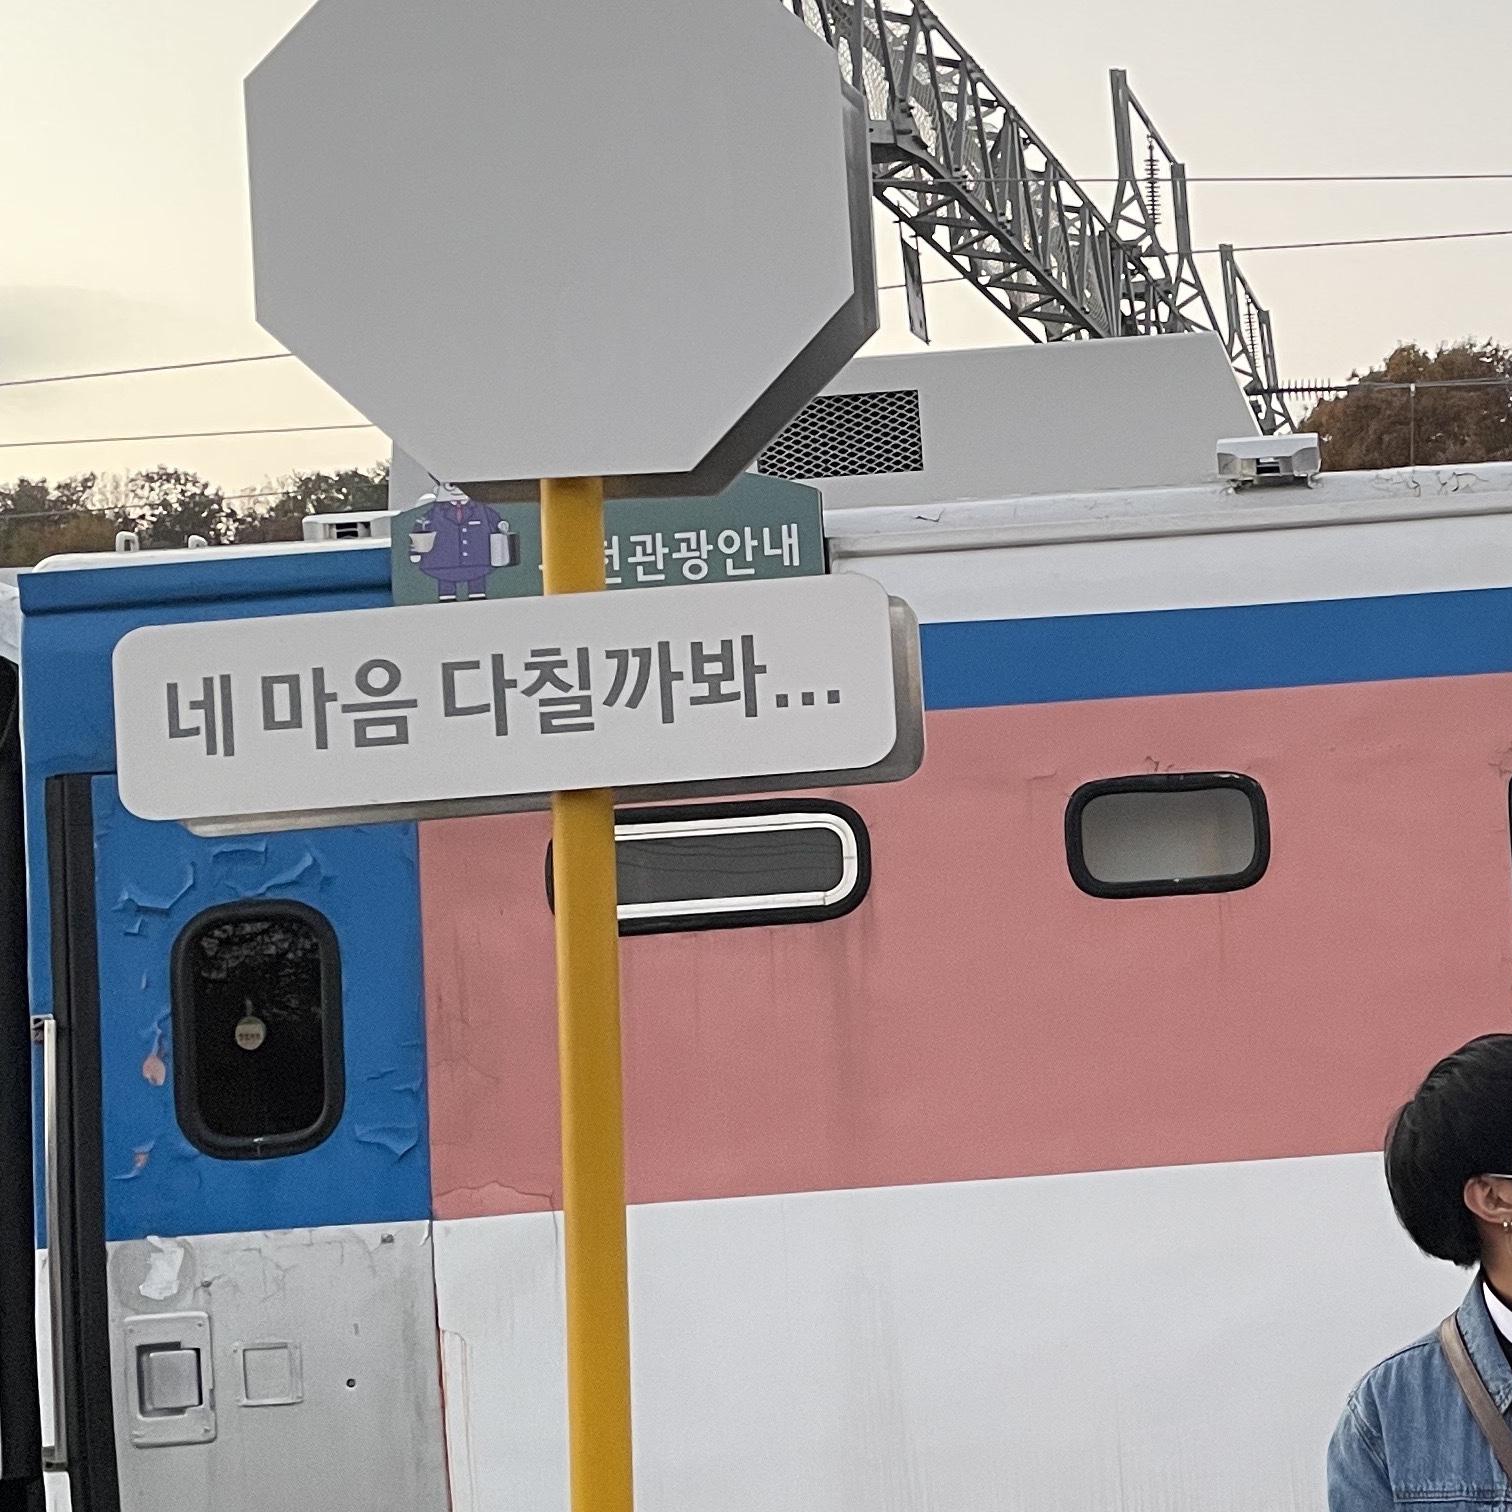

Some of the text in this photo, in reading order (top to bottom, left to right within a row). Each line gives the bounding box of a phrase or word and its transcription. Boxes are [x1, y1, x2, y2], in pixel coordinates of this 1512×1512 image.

[538, 523, 800, 585] 관광안내
[166, 634, 842, 757] 네 마음 다칠까봐...
